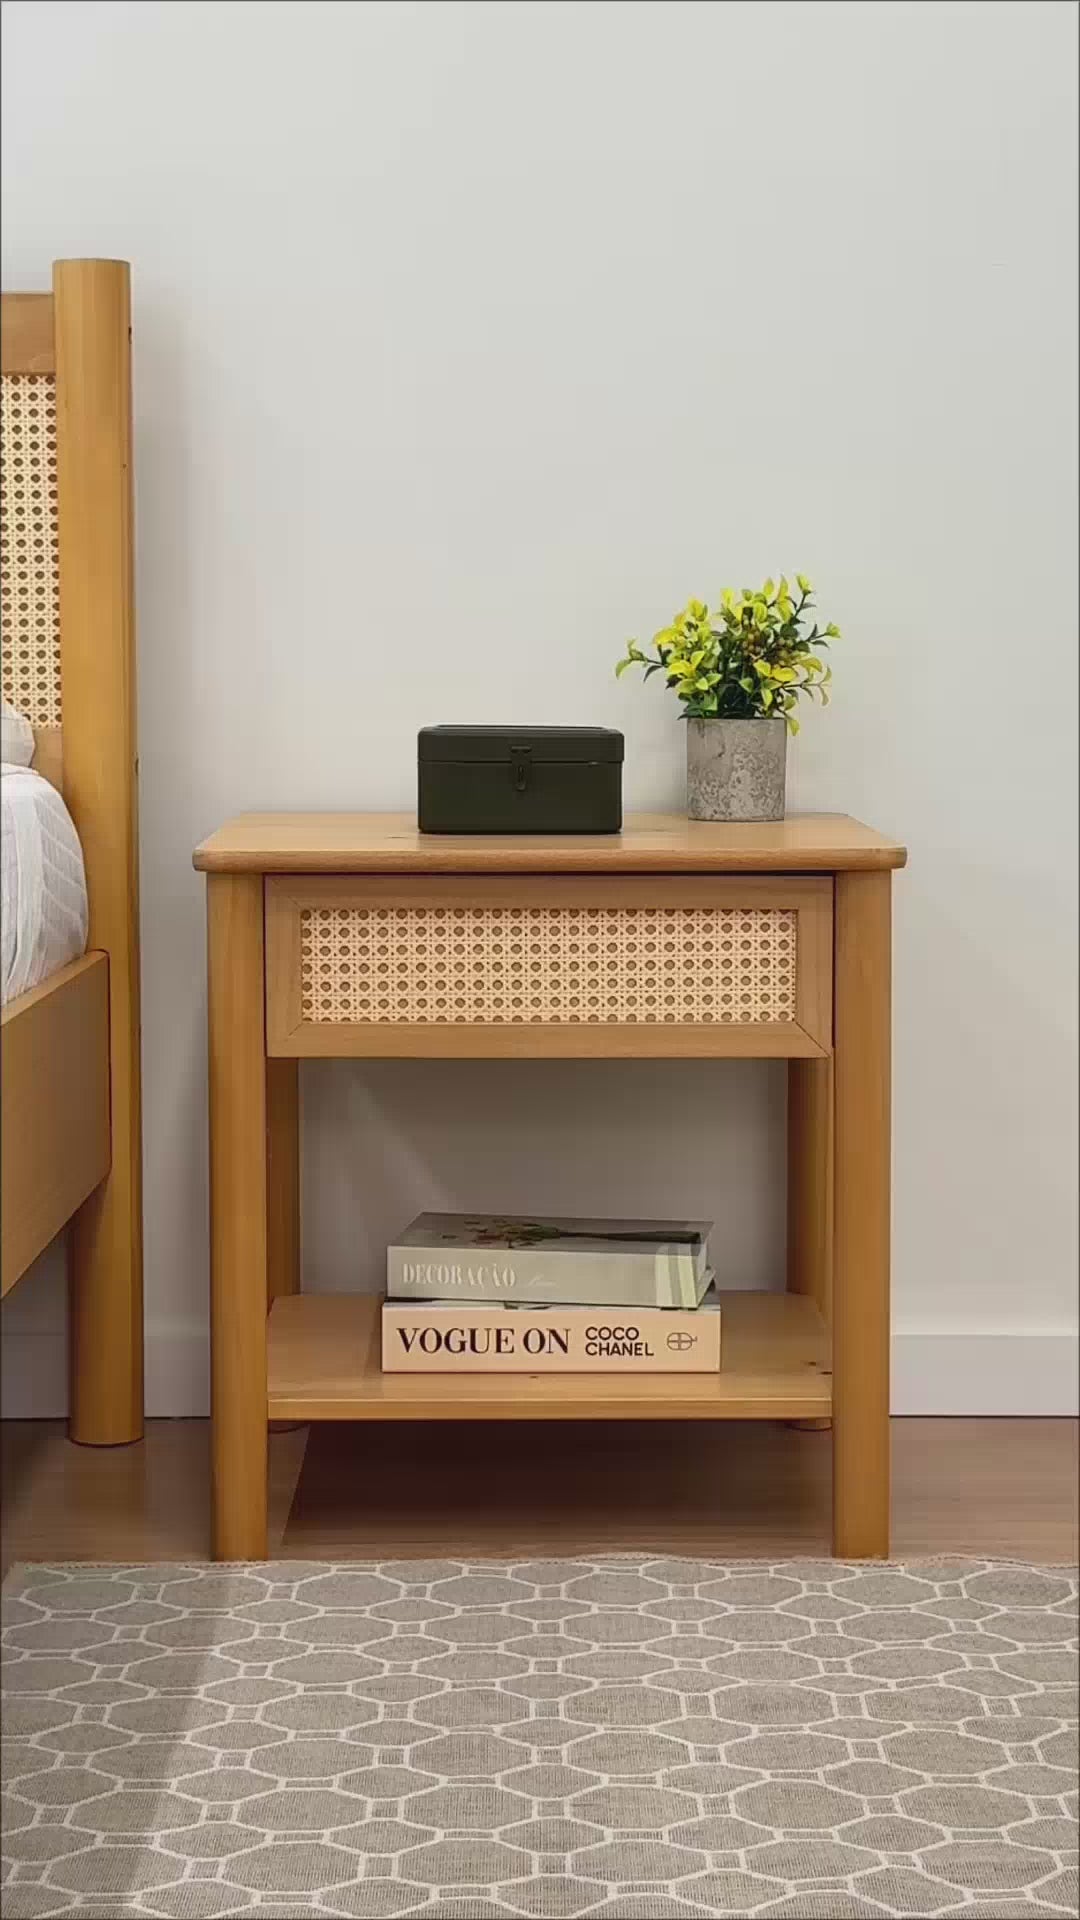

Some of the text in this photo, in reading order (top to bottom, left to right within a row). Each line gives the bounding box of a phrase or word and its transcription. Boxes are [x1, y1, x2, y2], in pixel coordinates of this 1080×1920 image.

[402, 1263, 516, 1288] DECORAÇÃO
[396, 1328, 571, 1354] VOGUE ON
[585, 1326, 640, 1341] COCO
[585, 1342, 654, 1356] CHANEL
